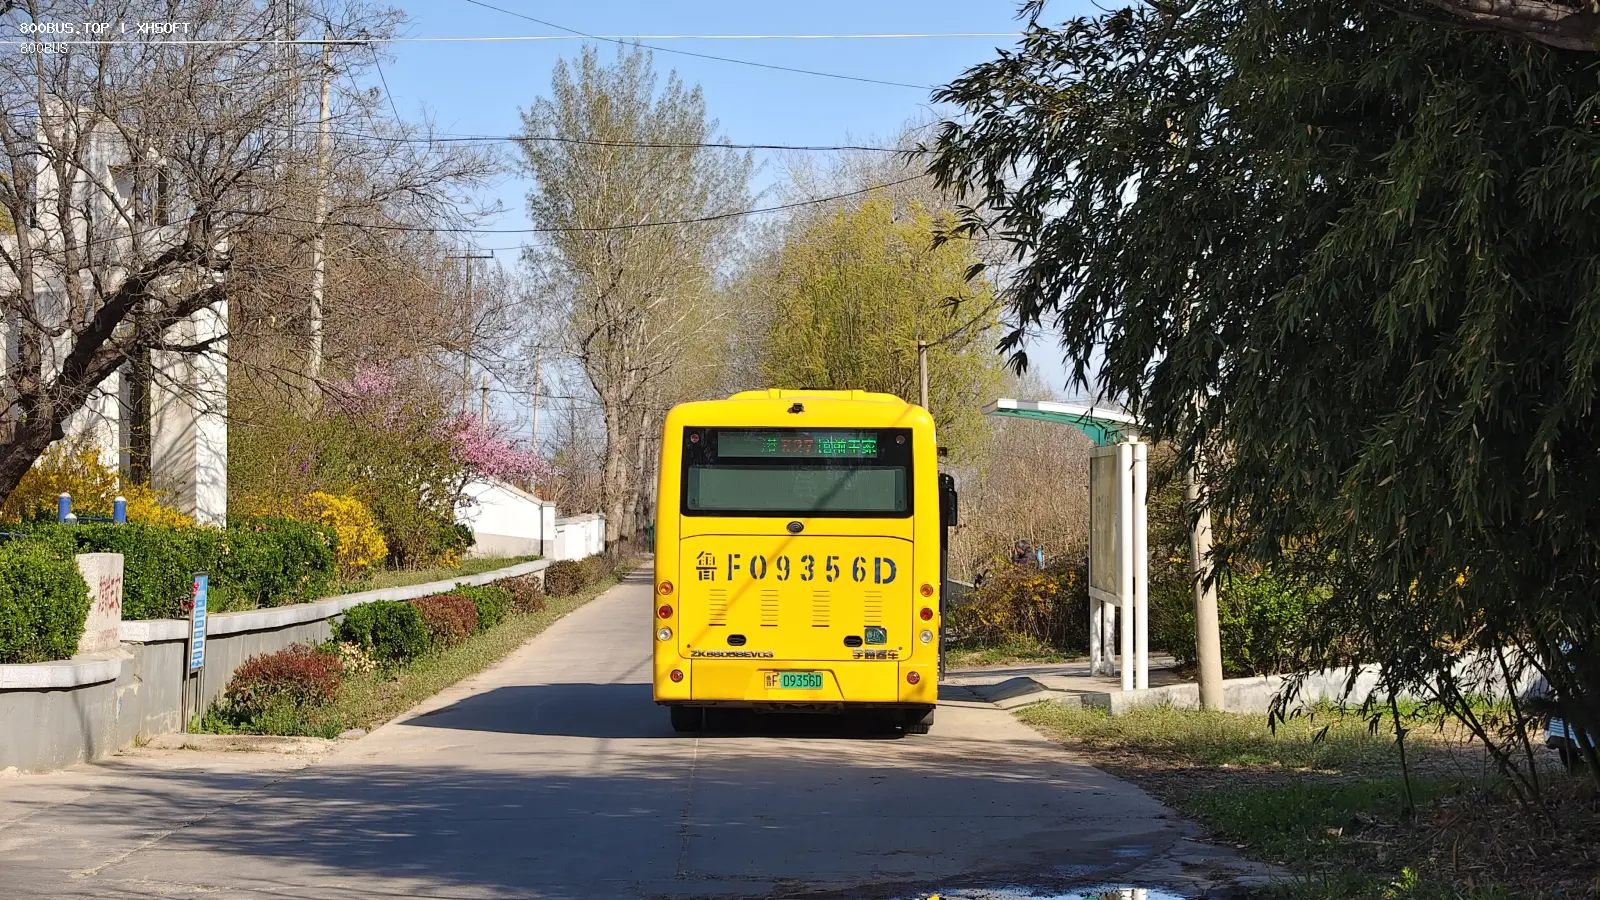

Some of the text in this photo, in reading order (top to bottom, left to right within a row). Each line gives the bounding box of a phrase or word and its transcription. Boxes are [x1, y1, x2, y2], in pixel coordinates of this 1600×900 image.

[695, 551, 897, 585] 鲁F09356D
[852, 649, 899, 660] 宇通客车
